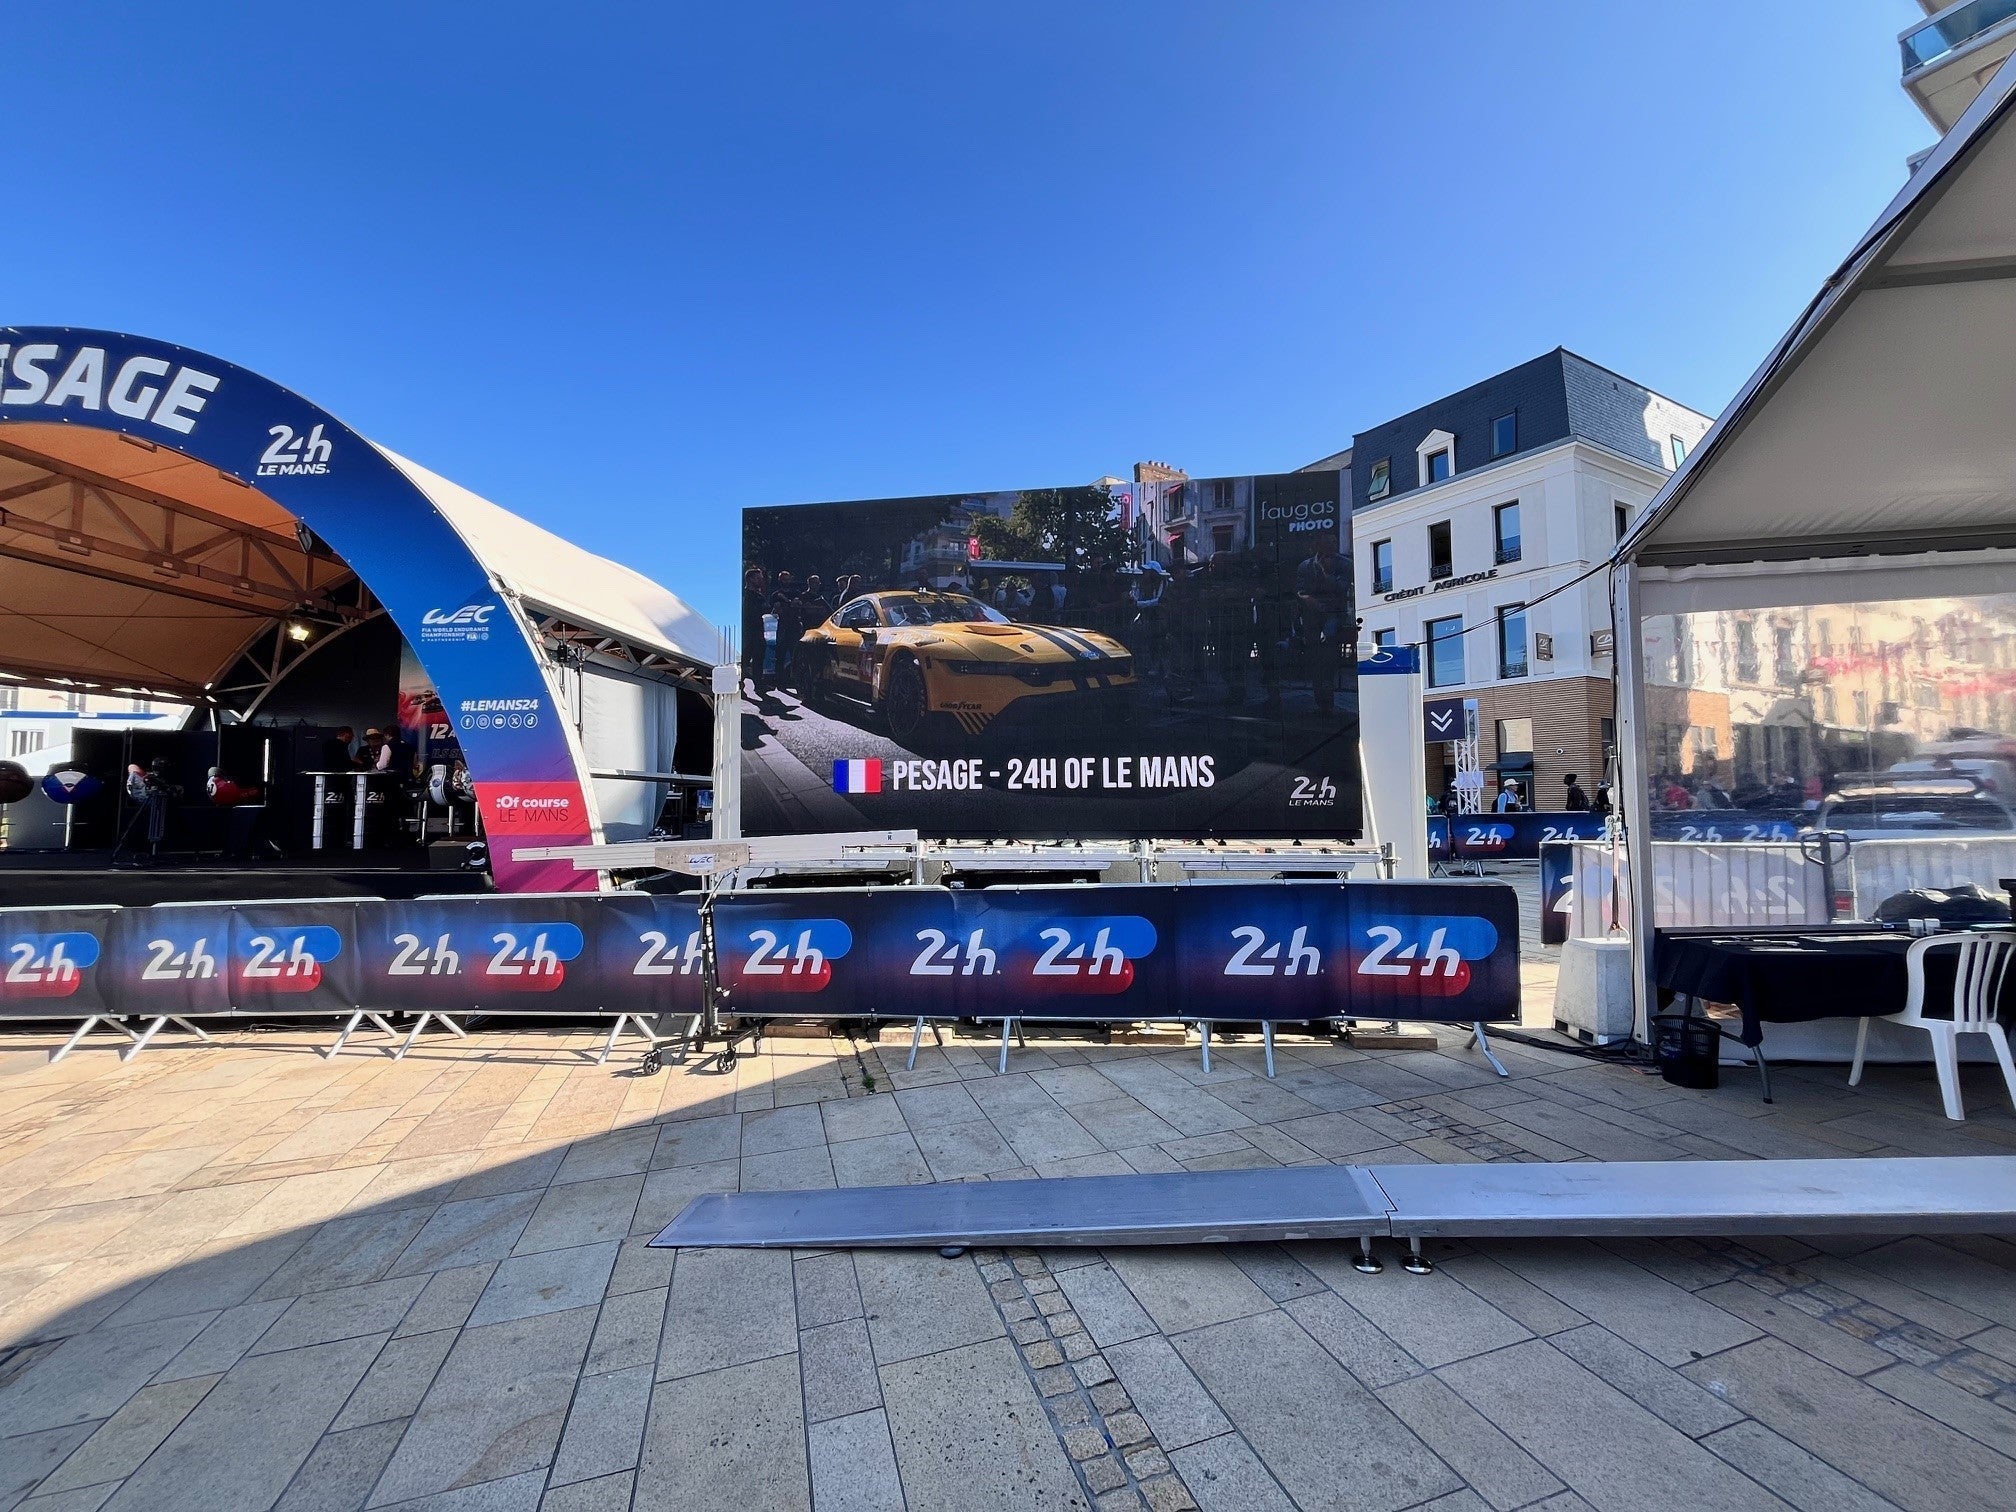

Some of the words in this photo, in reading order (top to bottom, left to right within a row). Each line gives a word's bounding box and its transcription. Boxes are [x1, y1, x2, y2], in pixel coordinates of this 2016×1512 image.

[0, 344, 220, 434] SAGE
[259, 424, 332, 464] 24h
[257, 465, 278, 476] LE
[1261, 500, 1334, 520] faugas
[1289, 519, 1334, 532] PHOTO
[1384, 585, 1426, 602] CRÉDIT
[1433, 569, 1498, 592] AGRICOLE
[422, 605, 495, 624] WEC
[461, 699, 539, 711] #LEMANS24
[430, 723, 449, 739] 12
[893, 759, 983, 791] PESAGE
[1007, 758, 1057, 790] 24H
[1064, 757, 1096, 789] OF
[1102, 757, 1132, 788] LE
[1139, 755, 1215, 788] MANS
[1290, 776, 1337, 799] 24h
[500, 809, 517, 822] LE
[524, 808, 569, 821] MANS
[522, 798, 569, 808] course
[1466, 827, 1502, 845] 24h
[5, 942, 75, 982] 24h
[142, 938, 219, 980] 24h
[243, 936, 315, 977] 24h
[388, 933, 459, 975] 24h
[486, 932, 557, 975] 24h
[743, 929, 827, 975] 24h
[910, 928, 997, 976] 24h
[1032, 927, 1124, 976] 24h
[1224, 926, 1321, 976] 24h
[1358, 927, 1461, 977] 24h
